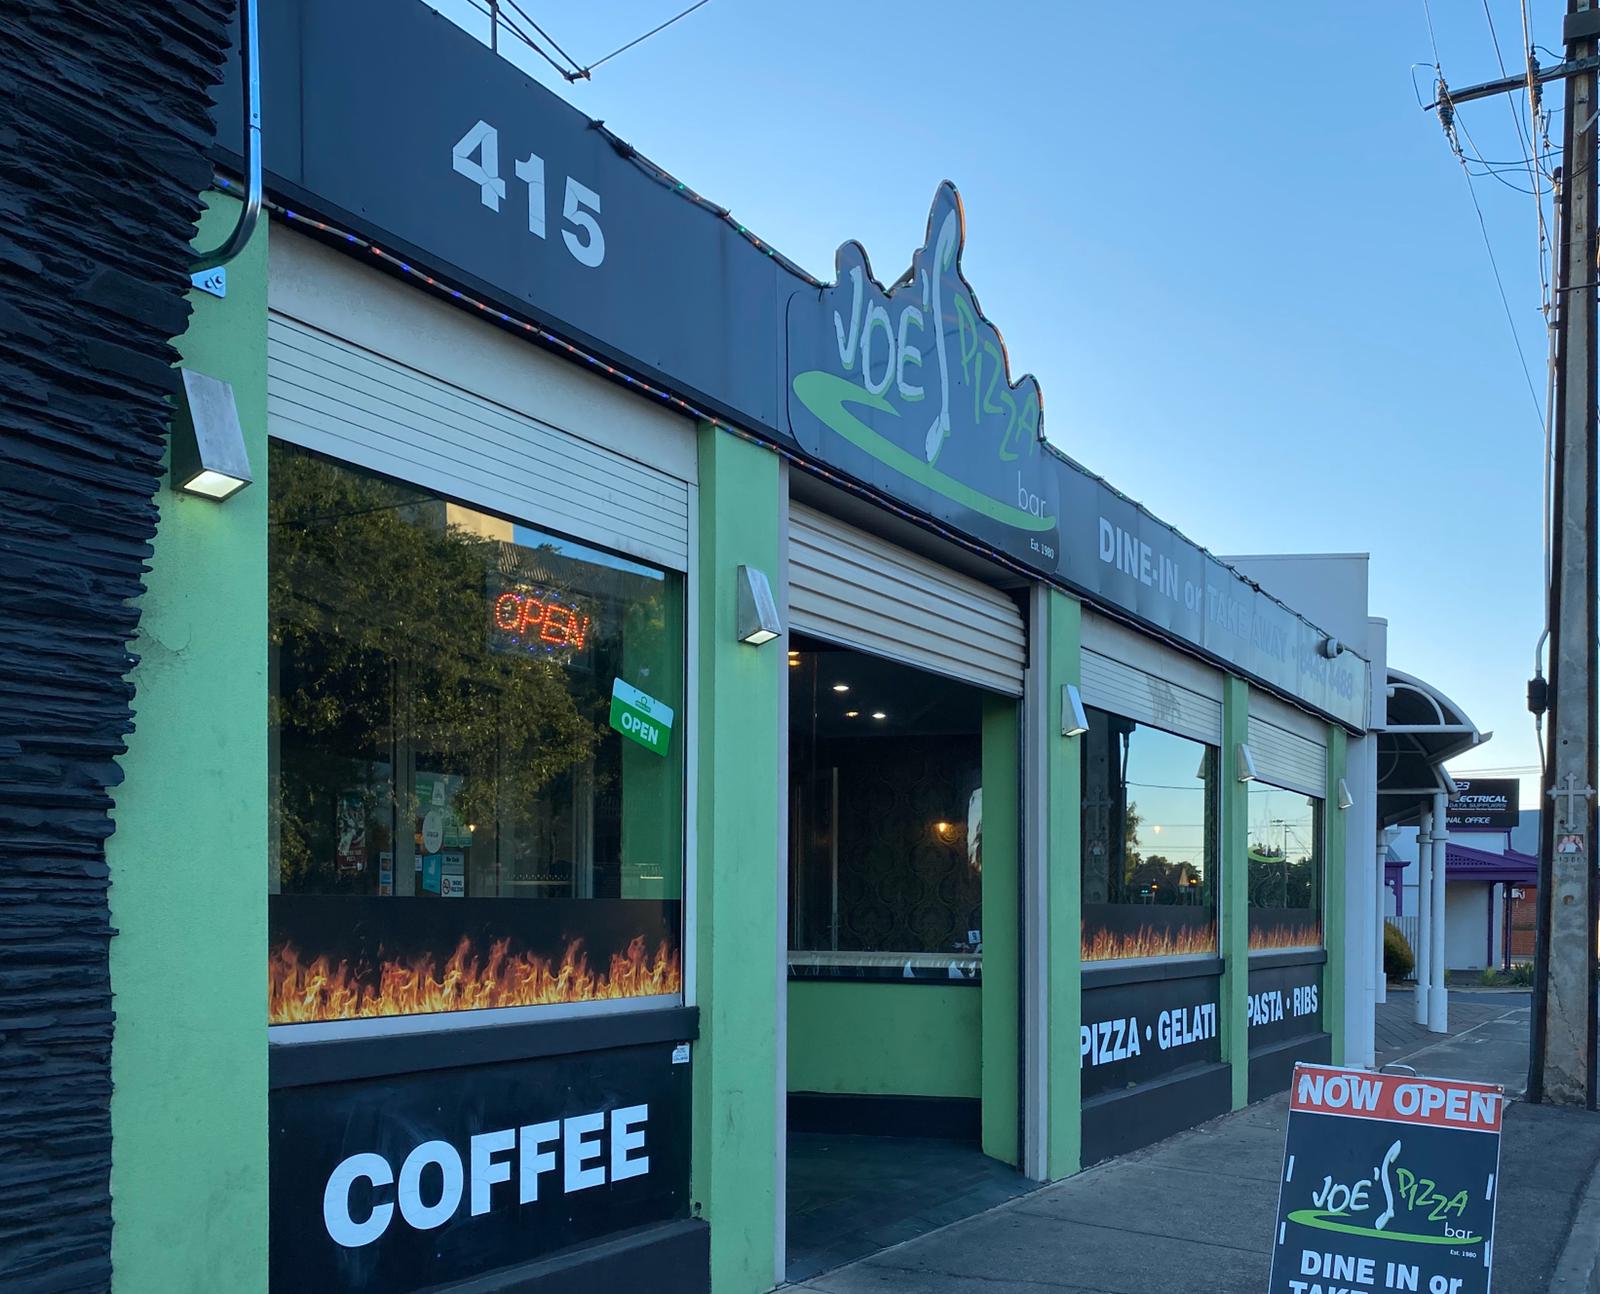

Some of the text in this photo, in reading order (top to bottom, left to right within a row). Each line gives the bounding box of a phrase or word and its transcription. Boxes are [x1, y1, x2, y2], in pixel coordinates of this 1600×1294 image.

[452, 119, 606, 269] 415
[954, 293, 1039, 461] PIZZA
[1018, 470, 1047, 520] bar
[1041, 543, 1055, 560] 1980
[495, 592, 590, 651] OPEN
[621, 711, 659, 745] OPEN
[1455, 781, 1471, 791] 23
[1464, 816, 1491, 824] OFFICE
[1247, 984, 1318, 1027] PASTA RIBS
[1080, 1003, 1216, 1068] PIZZA GELATI
[1298, 1074, 1498, 1124] NOW OPEN
[323, 1103, 650, 1248] COFFEE
[1396, 1168, 1468, 1221] PIZZA
[1444, 1222, 1473, 1240] bar
[1300, 1249, 1376, 1285] DINE
[1385, 1262, 1420, 1292] IN
[1429, 1275, 1463, 1294] or
